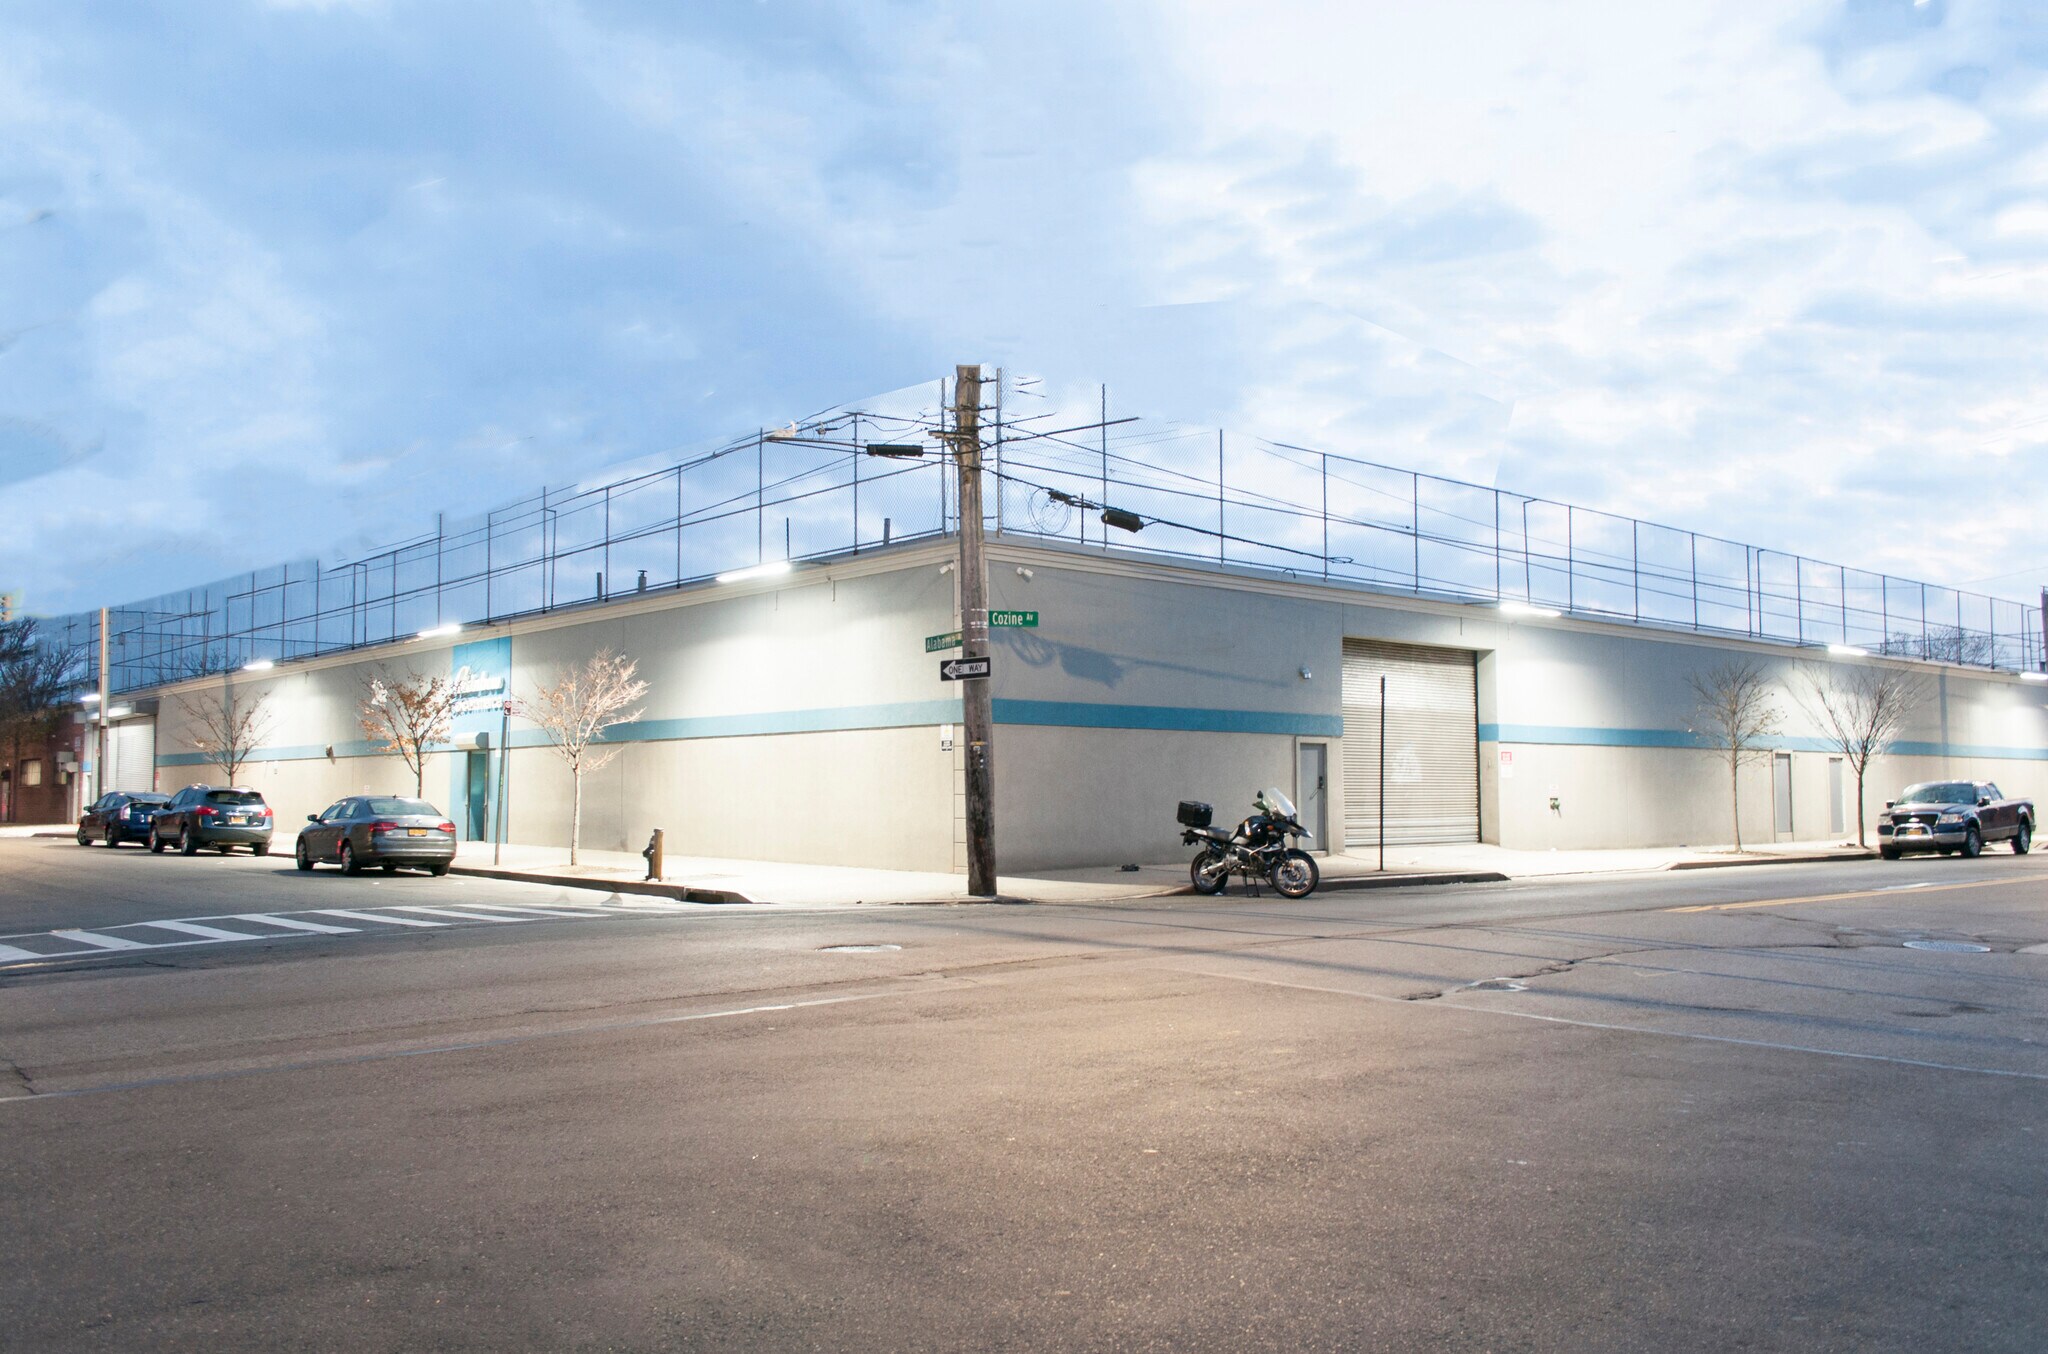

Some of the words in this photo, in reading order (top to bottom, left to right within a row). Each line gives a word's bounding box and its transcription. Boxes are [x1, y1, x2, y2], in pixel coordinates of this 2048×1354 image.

[992, 612, 1023, 625] Cozine
[926, 635, 956, 651] Alabama
[948, 665, 962, 675] ONE
[968, 663, 983, 673] WAY
